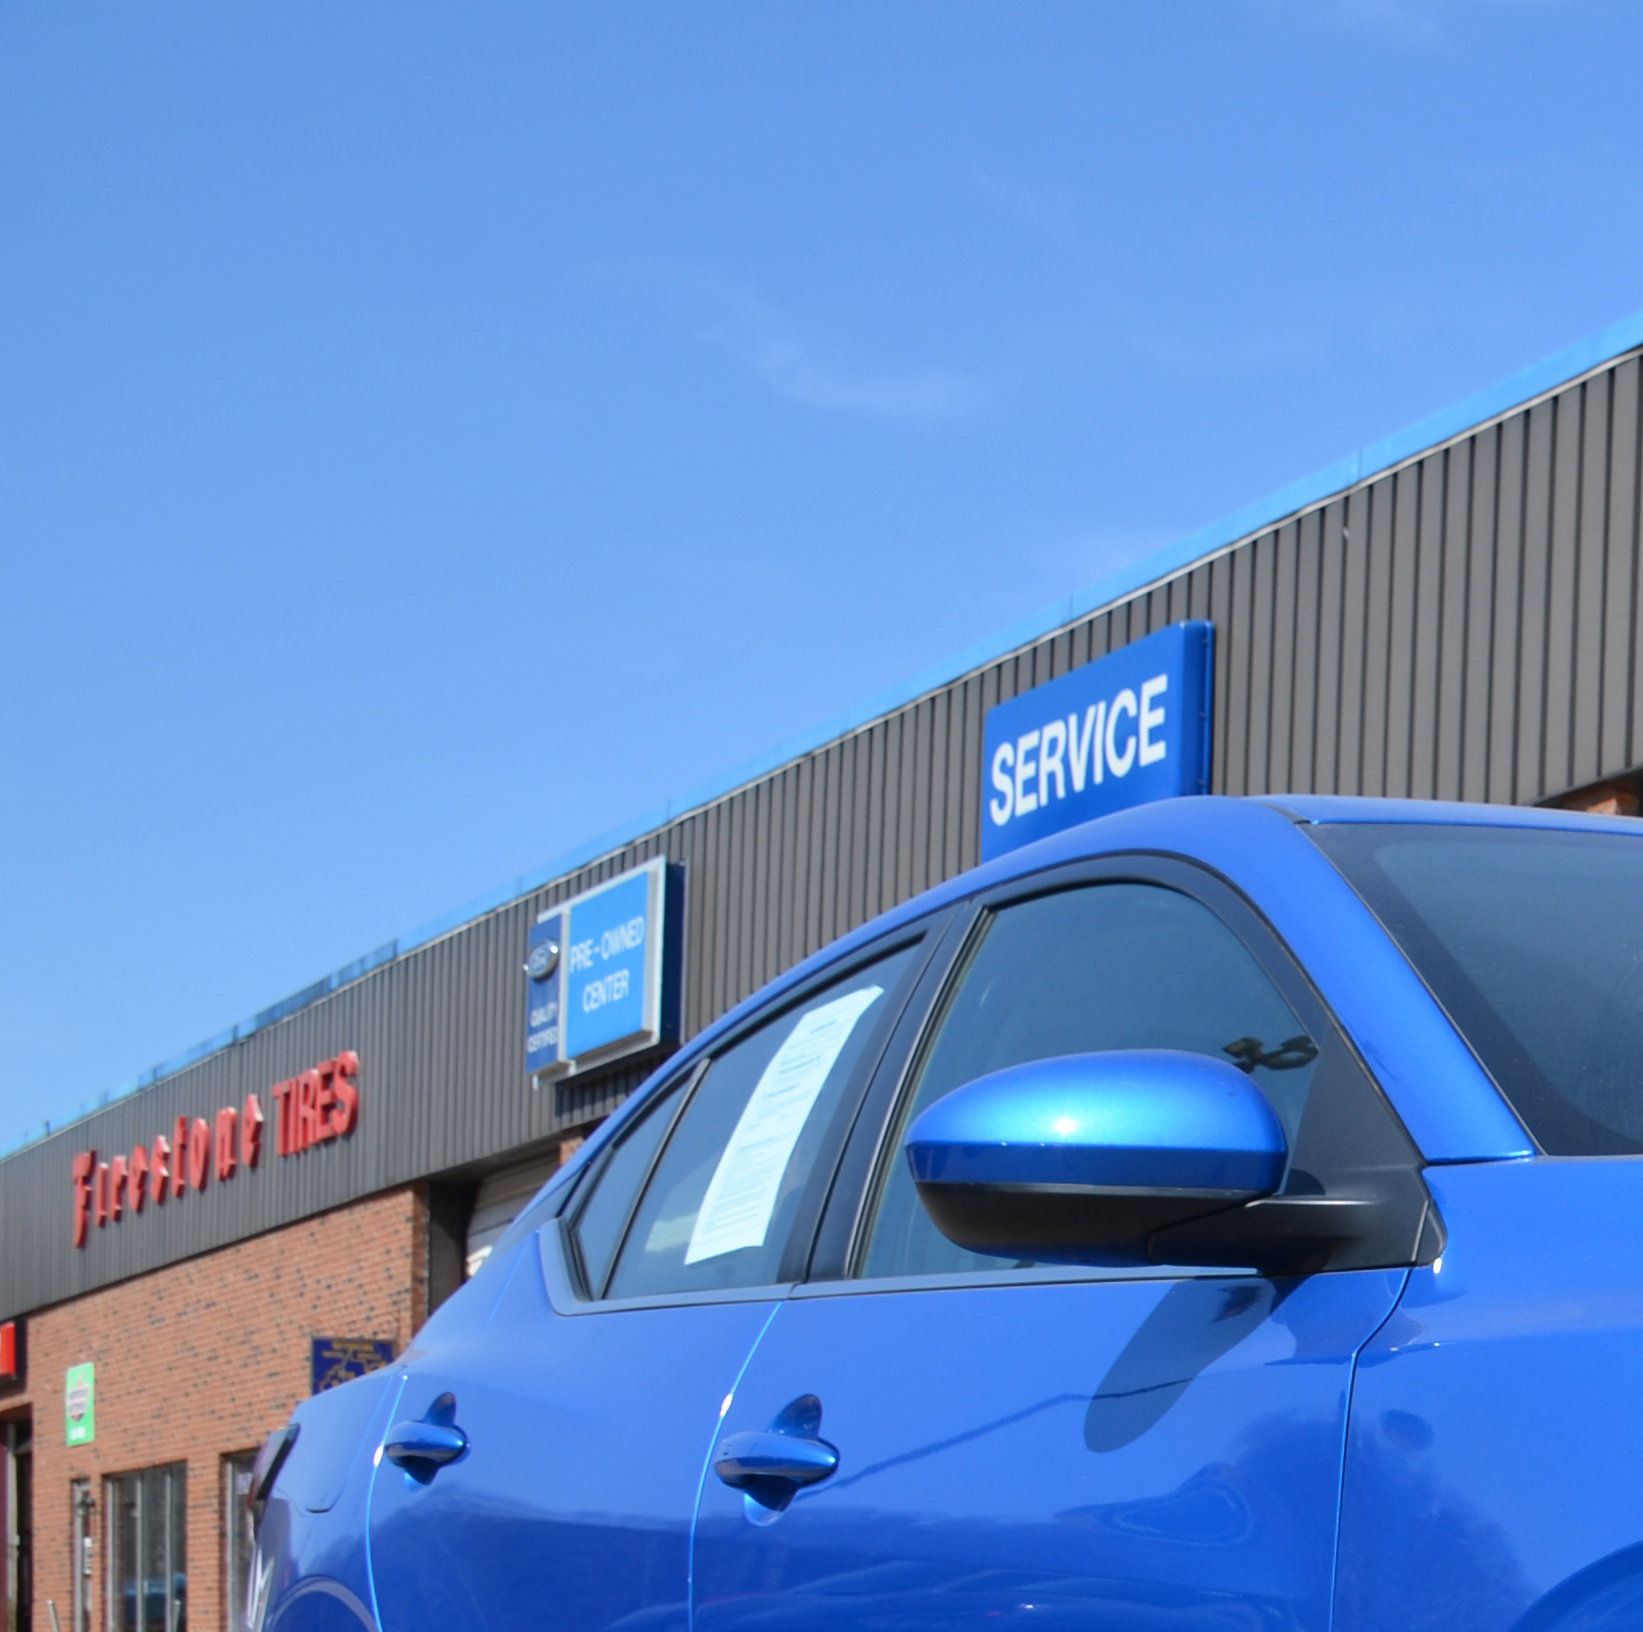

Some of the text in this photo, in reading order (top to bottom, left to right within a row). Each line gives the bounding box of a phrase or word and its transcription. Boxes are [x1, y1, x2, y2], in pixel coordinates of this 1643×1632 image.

[989, 673, 1168, 826] SERVICE
[582, 968, 630, 1013] CENTER
[72, 1049, 360, 1249] Firestone TIRES
